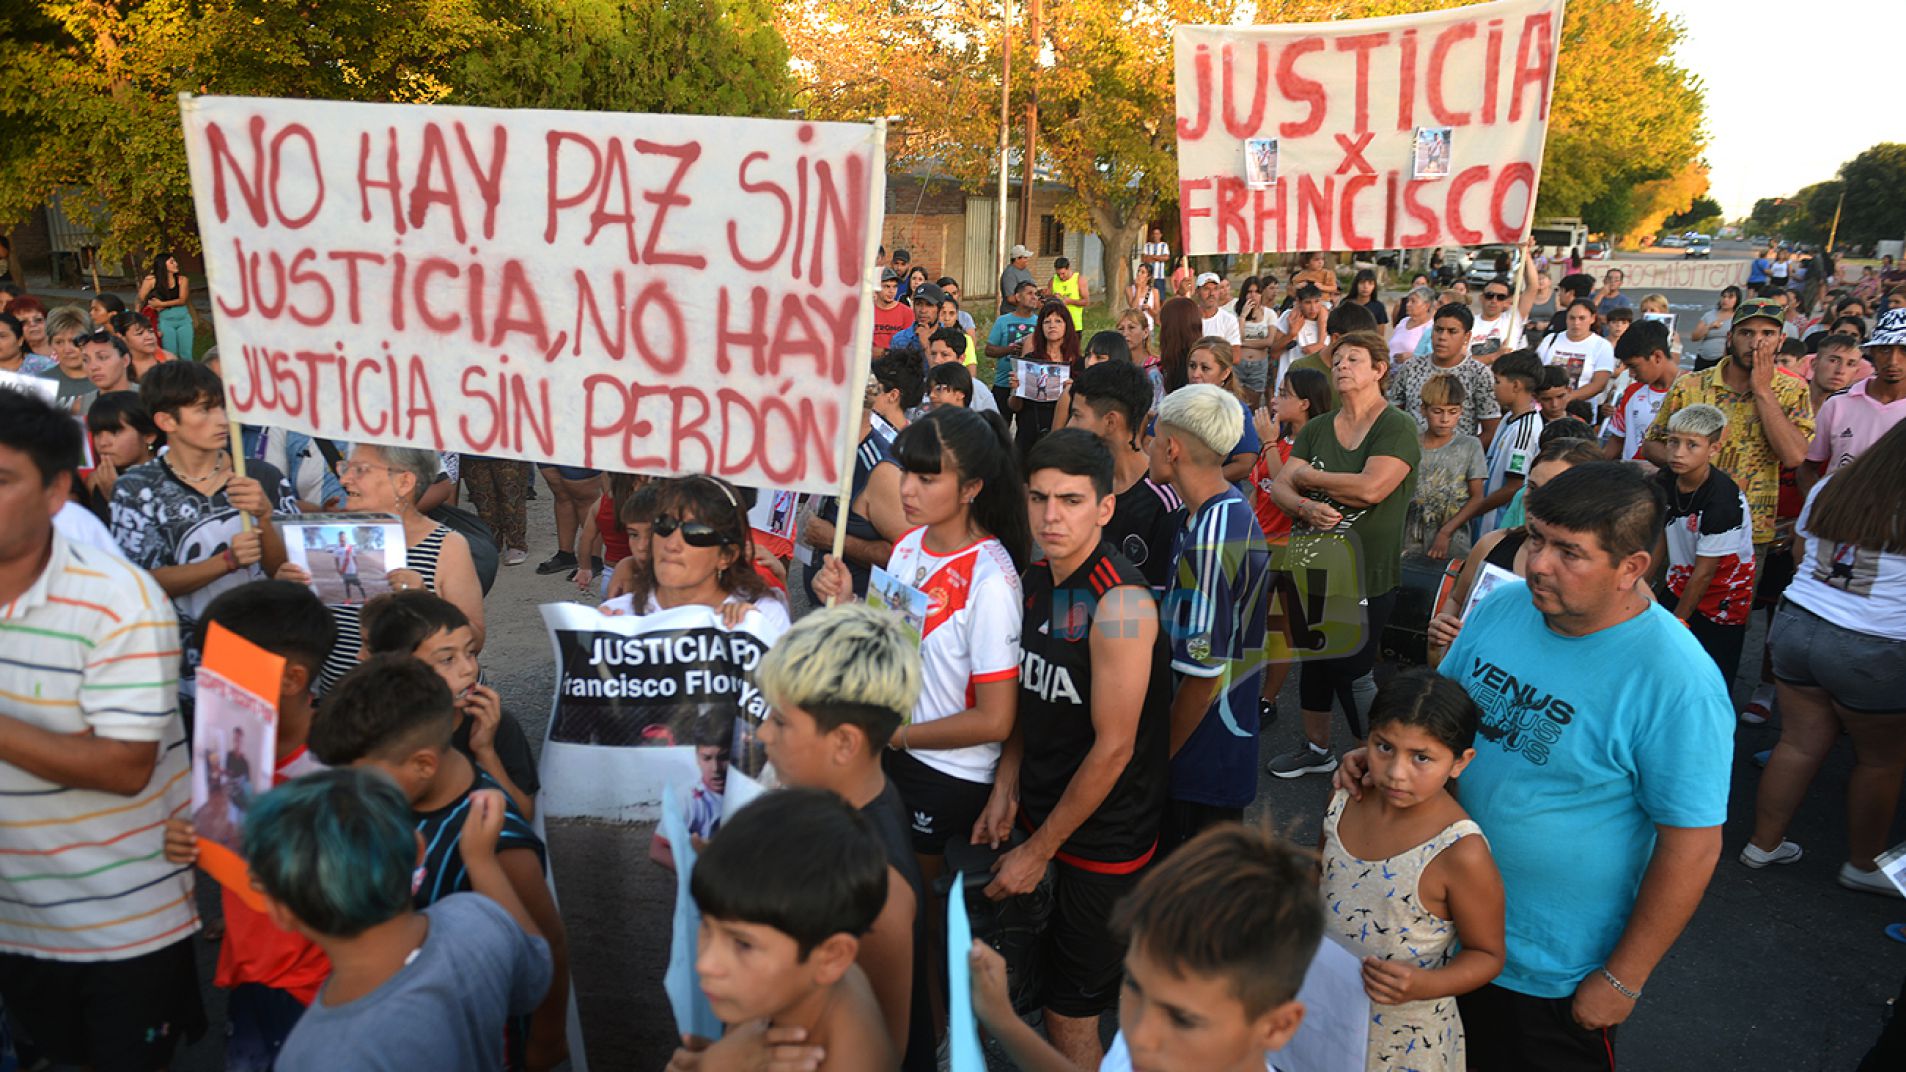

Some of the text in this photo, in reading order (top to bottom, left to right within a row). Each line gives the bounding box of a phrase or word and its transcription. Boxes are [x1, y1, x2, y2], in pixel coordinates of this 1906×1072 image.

[1176, 12, 1552, 140] JUSTICIA
[205, 115, 863, 288] NO HAY PAZ SIN
[1179, 161, 1536, 255] FRANCISCO
[571, 269, 688, 375] NO
[715, 285, 862, 385] HAY
[229, 340, 840, 486] JUSTICIA SIN PERDÓN
[563, 672, 677, 698] rancisco
[589, 634, 728, 666] JUSTICIA
[1472, 657, 1576, 725] VENUS
